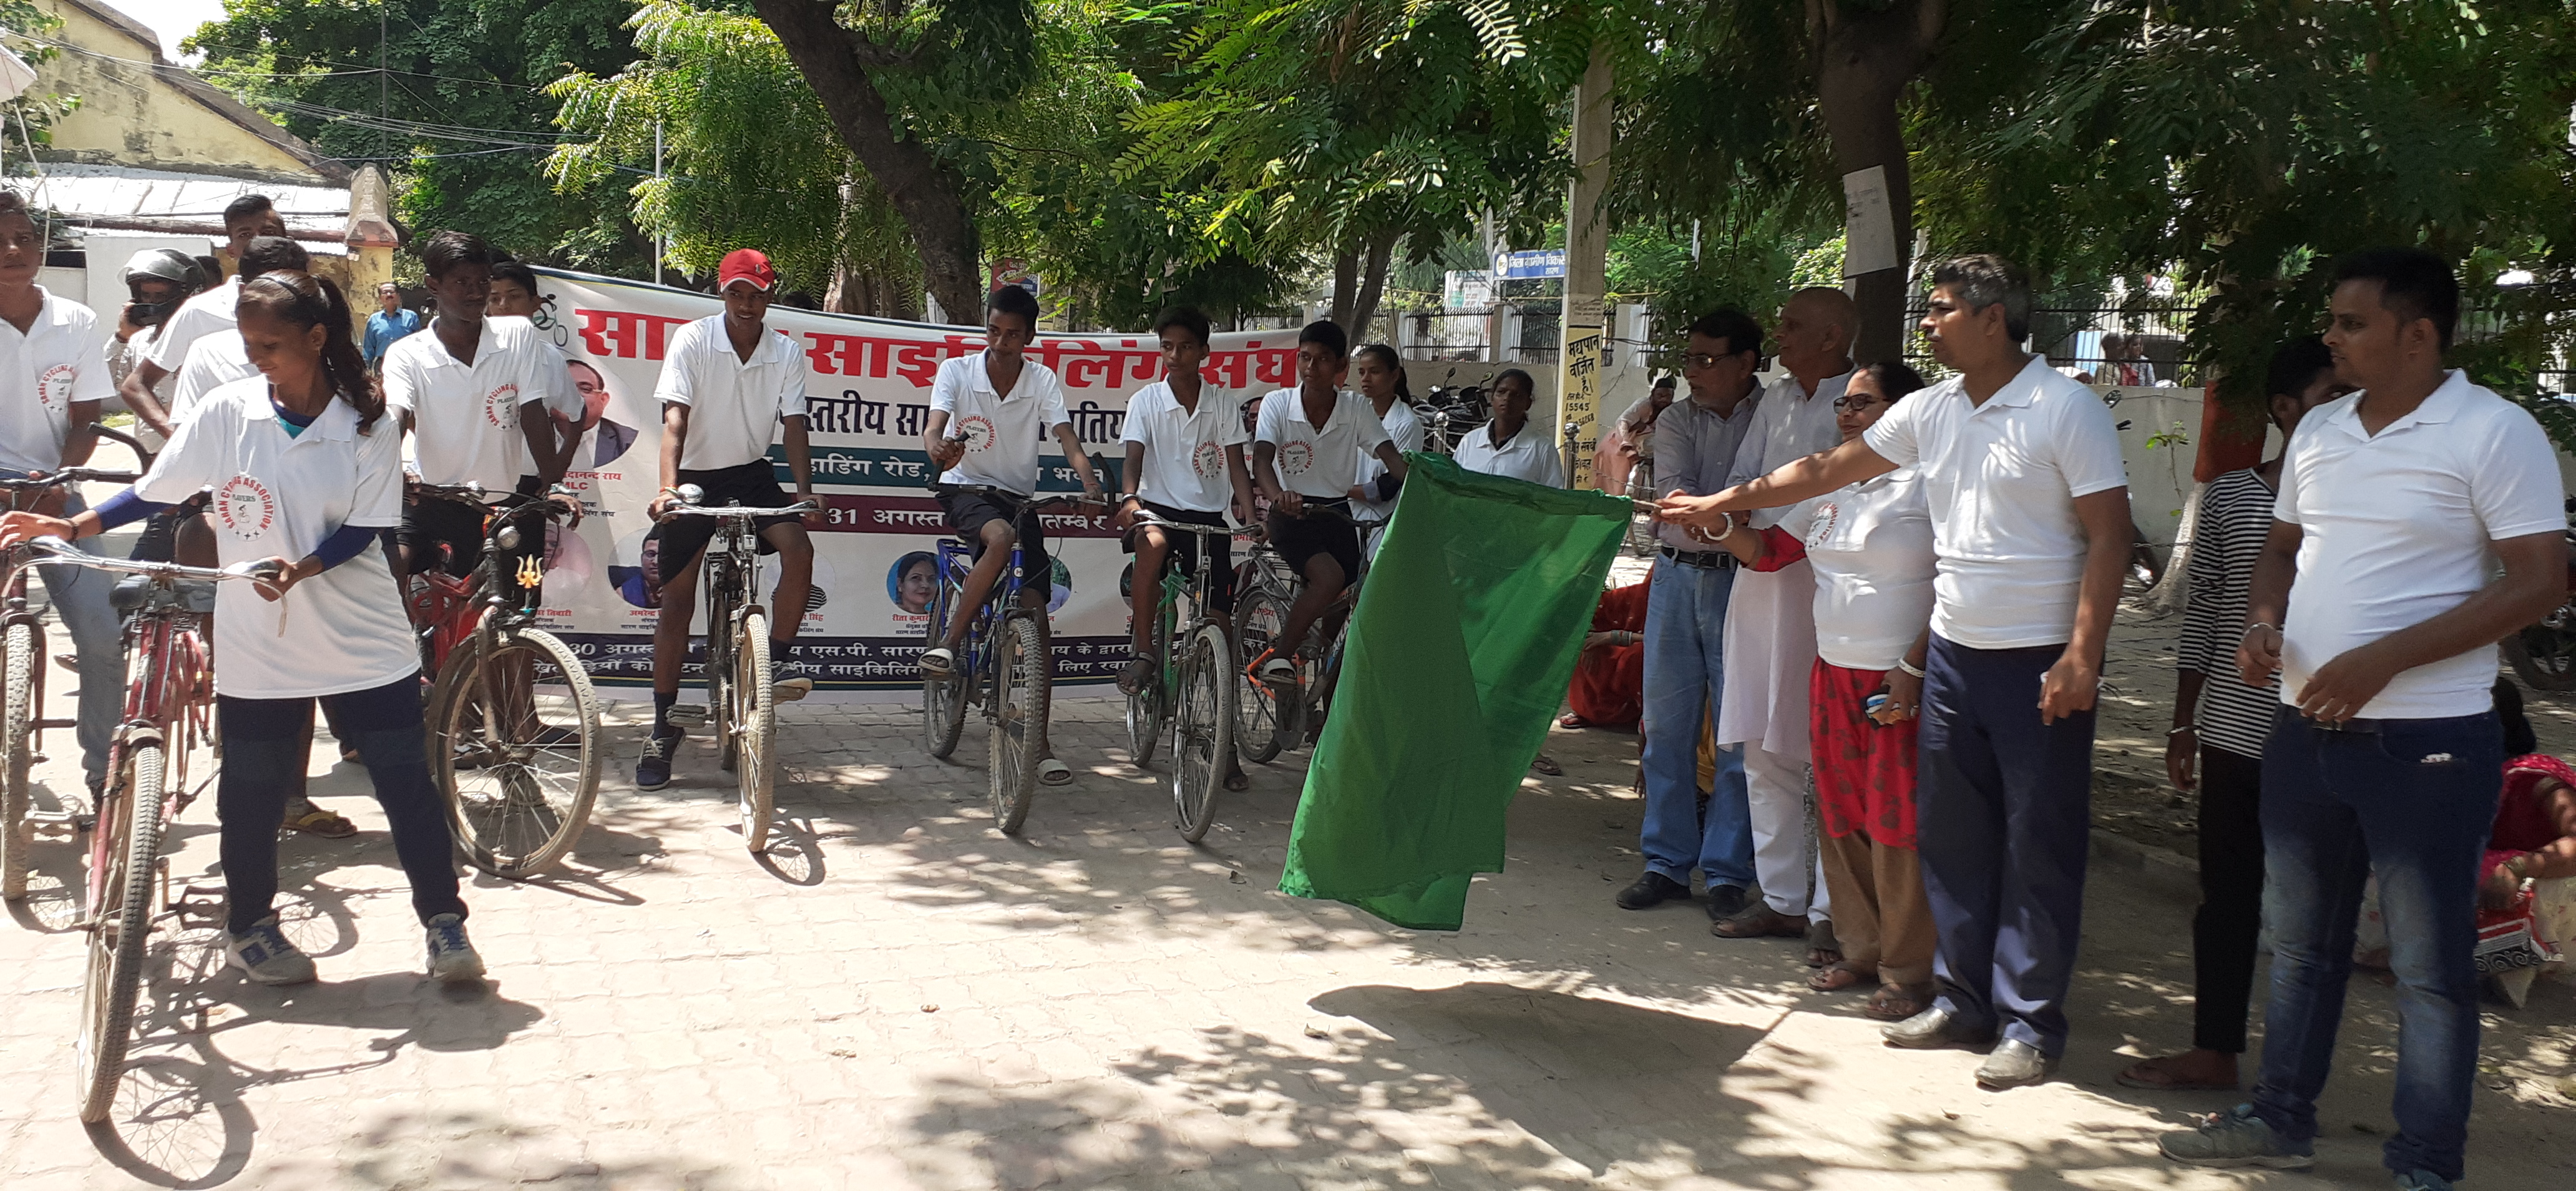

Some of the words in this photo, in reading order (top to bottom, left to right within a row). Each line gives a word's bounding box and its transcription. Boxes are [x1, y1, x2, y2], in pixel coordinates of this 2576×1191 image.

[1509, 255, 1524, 268] जिला
[1568, 334, 1599, 358] मद्यपान
[1198, 340, 1300, 388] संघ
[1569, 355, 1595, 378] वर्जित
[1566, 402, 1591, 412] 15545
[565, 471, 600, 481] दानन्द
[602, 473, 622, 481] राय
[243, 477, 274, 531] ASSOCIATION
[828, 508, 857, 524] 31
[872, 509, 945, 527] अगस्त
[1038, 514, 1108, 531] तम्बर
[809, 613, 824, 622] सिंह
[892, 614, 907, 622] रीता
[809, 642, 873, 659] एस.पी.
[1076, 642, 1093, 655] के
[1058, 660, 1093, 674] लिए
